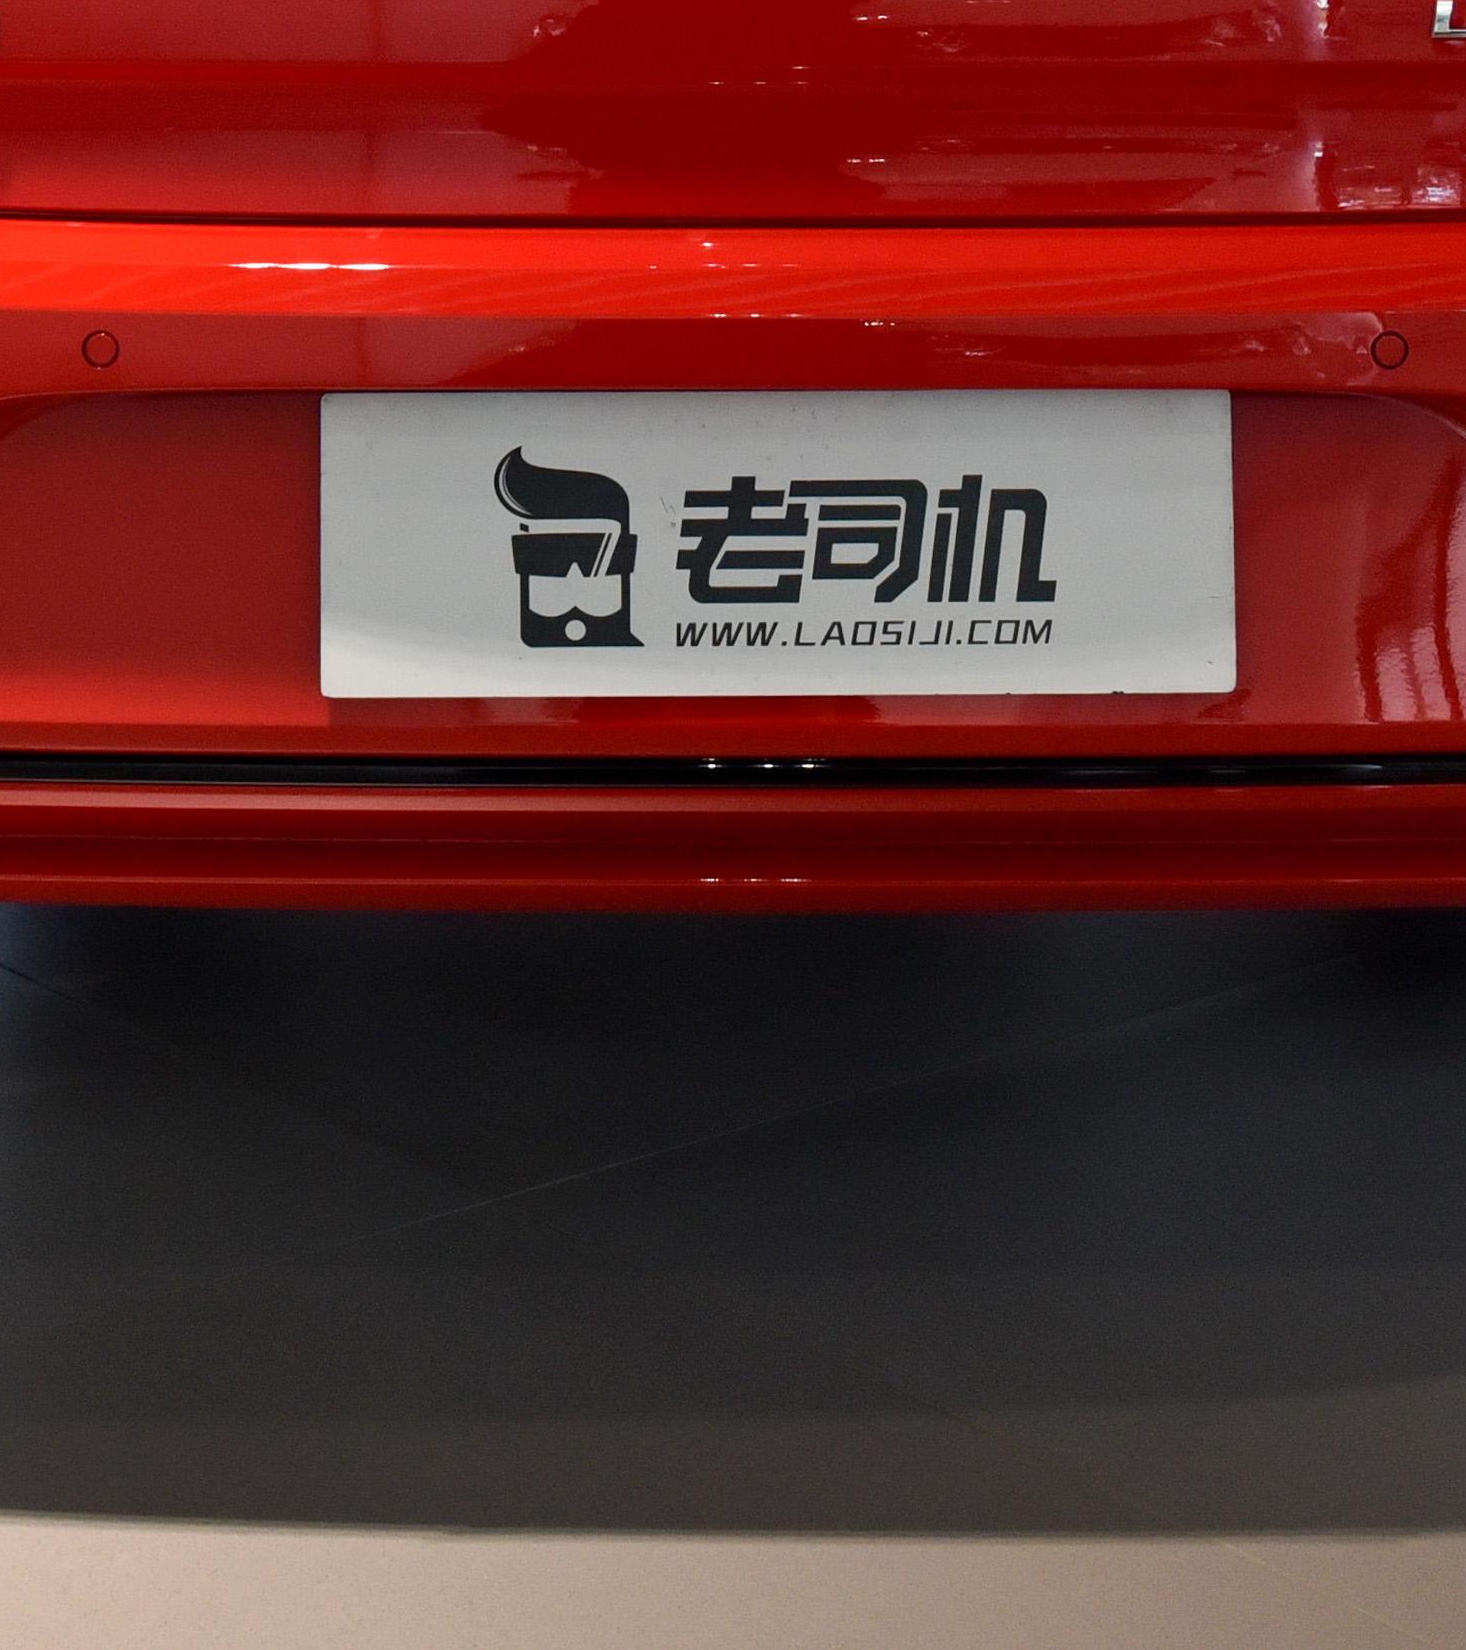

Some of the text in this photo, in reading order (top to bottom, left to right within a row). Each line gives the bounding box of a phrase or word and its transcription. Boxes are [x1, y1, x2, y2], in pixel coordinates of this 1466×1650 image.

[674, 473, 1058, 605] 老司机
[674, 618, 1054, 647] WWW.LAOSIJI.COM
